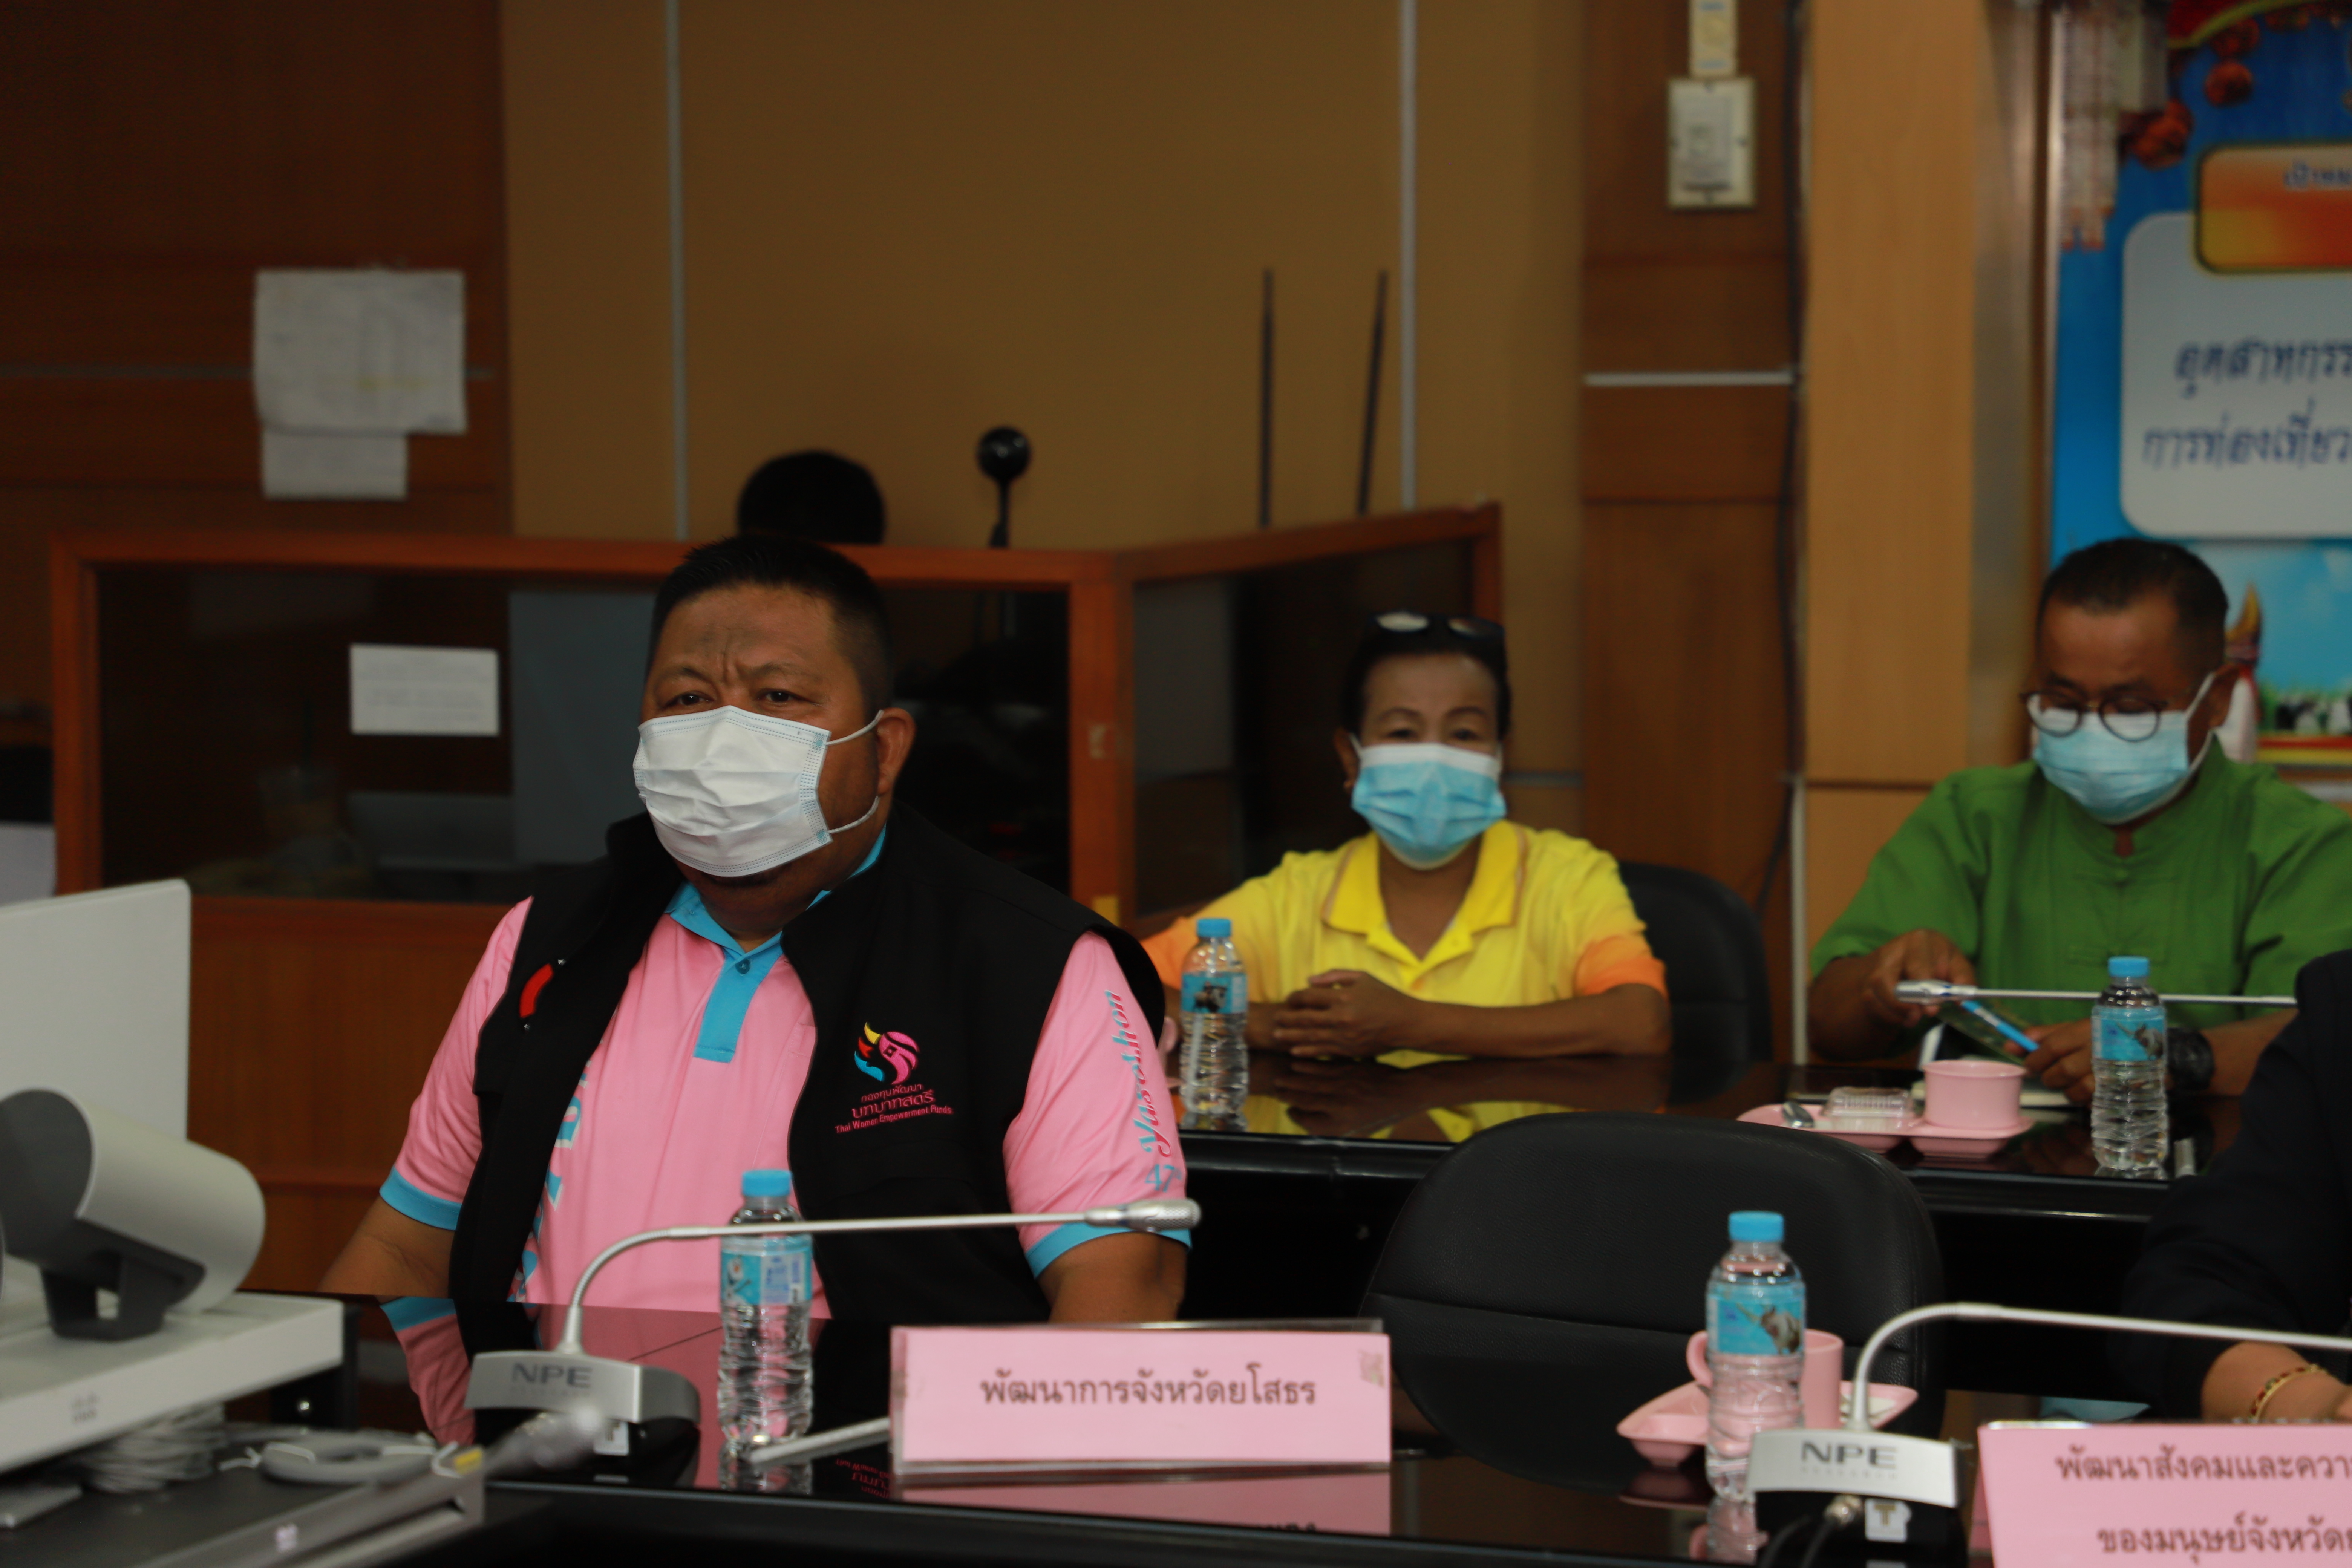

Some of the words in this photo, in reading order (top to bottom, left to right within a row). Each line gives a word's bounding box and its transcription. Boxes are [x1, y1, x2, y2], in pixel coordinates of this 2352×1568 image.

[1104, 989, 1172, 1158] Yasothon
[835, 1124, 851, 1133] Thai
[852, 1118, 878, 1129] Women
[879, 1107, 929, 1122] Empowerment
[930, 1104, 952, 1114] Funds
[851, 1089, 936, 1119] บทบาทสตรี
[511, 1361, 593, 1389] NPE
[980, 1362, 1317, 1406] พัฒนาการจังหวัดยโสธร
[1801, 1441, 1899, 1469] NPE
[2054, 1443, 2352, 1480] พัฒนาสังคมและควา
